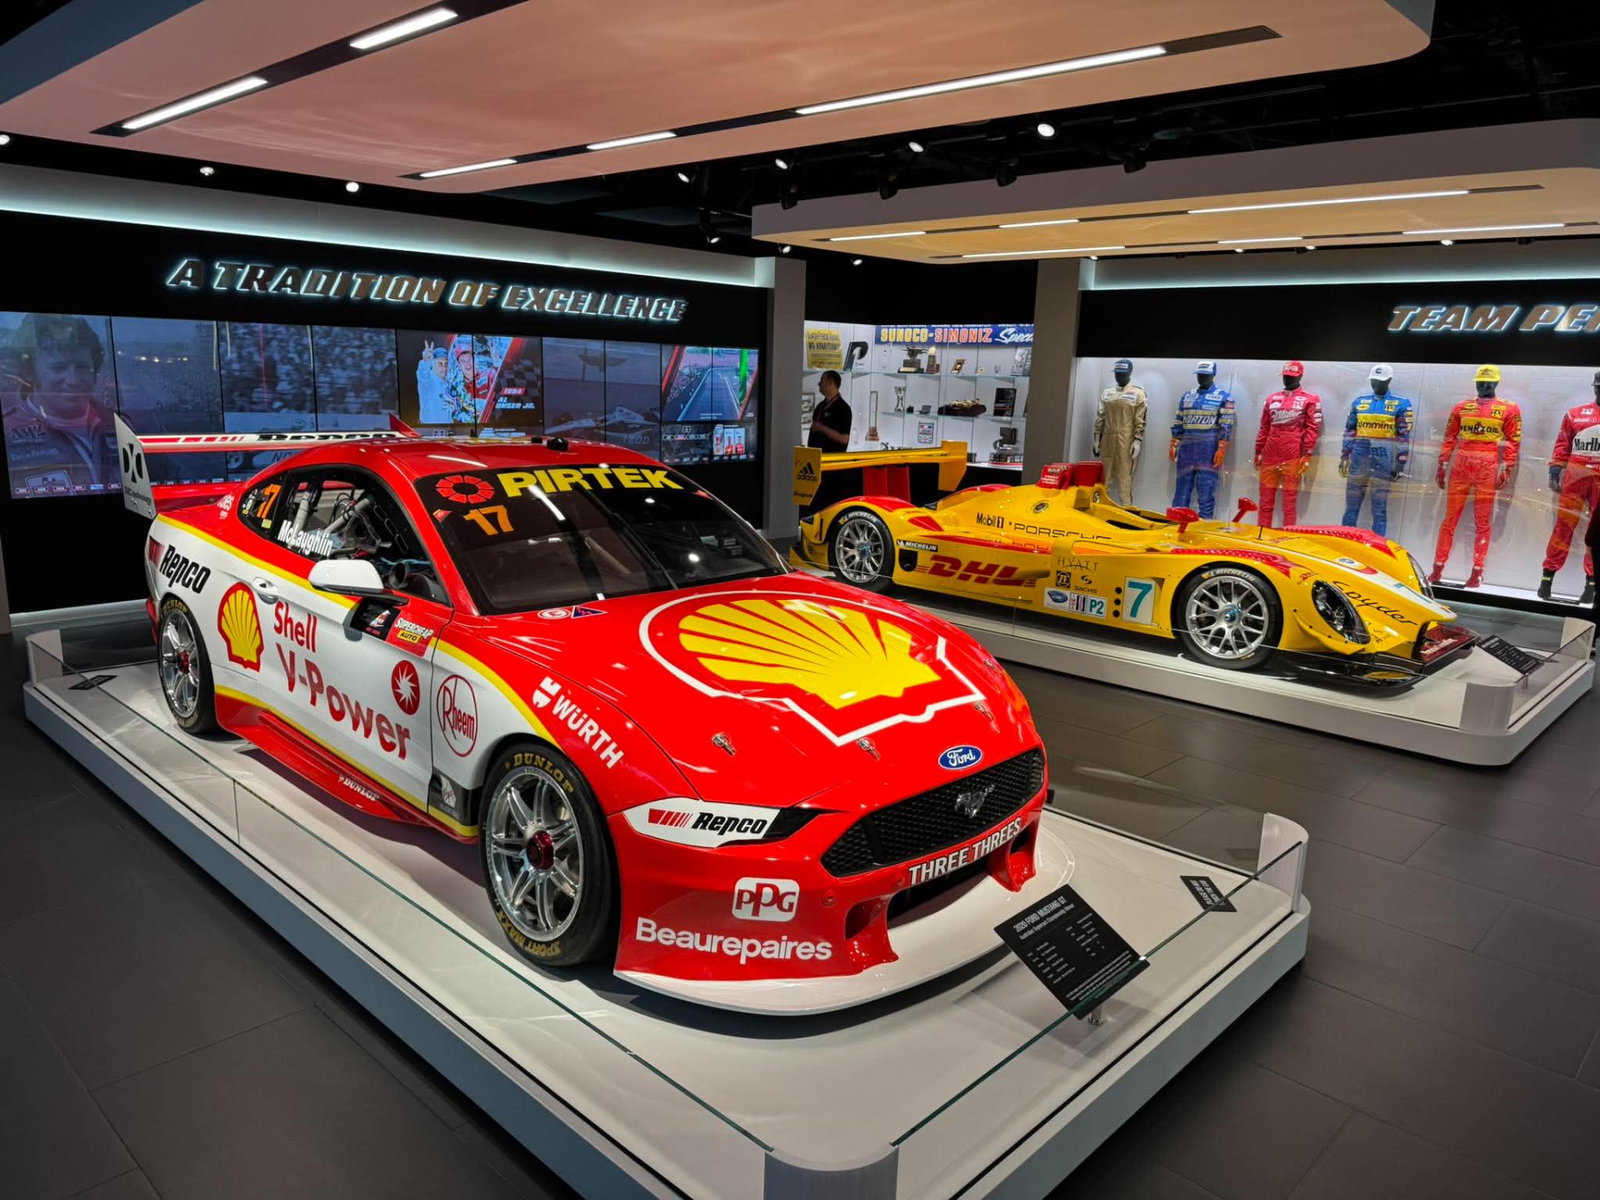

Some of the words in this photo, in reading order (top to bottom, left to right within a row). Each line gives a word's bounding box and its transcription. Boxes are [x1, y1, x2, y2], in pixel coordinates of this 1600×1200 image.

[166, 258, 202, 288] A
[212, 261, 447, 304] TRADITION
[449, 280, 500, 307] OF
[501, 285, 689, 322] EXCELLENCE
[1387, 304, 1520, 332] TEAM
[496, 467, 684, 498] PIRTEK
[257, 484, 282, 519] 17
[976, 512, 996, 528] Mobil
[278, 520, 334, 557] McLaughlin
[463, 505, 514, 536] 17
[159, 544, 212, 594] Repco
[928, 554, 1026, 587] DHL
[1089, 599, 1105, 615] P2
[1127, 581, 1153, 618] 7
[1332, 580, 1418, 626] Spyder
[274, 601, 318, 653] Shell
[400, 631, 418, 641] AUTO
[276, 643, 411, 761] V-Power
[442, 679, 475, 741] Rheem
[551, 694, 625, 769] WÜRTH
[513, 753, 574, 794] DUNLOP
[943, 747, 976, 768] Ford
[342, 776, 380, 801] DUNLOP
[691, 812, 769, 836] Repco
[908, 849, 968, 886] THREE
[971, 818, 1022, 861] THREES
[635, 917, 833, 964] Beaurepaires
